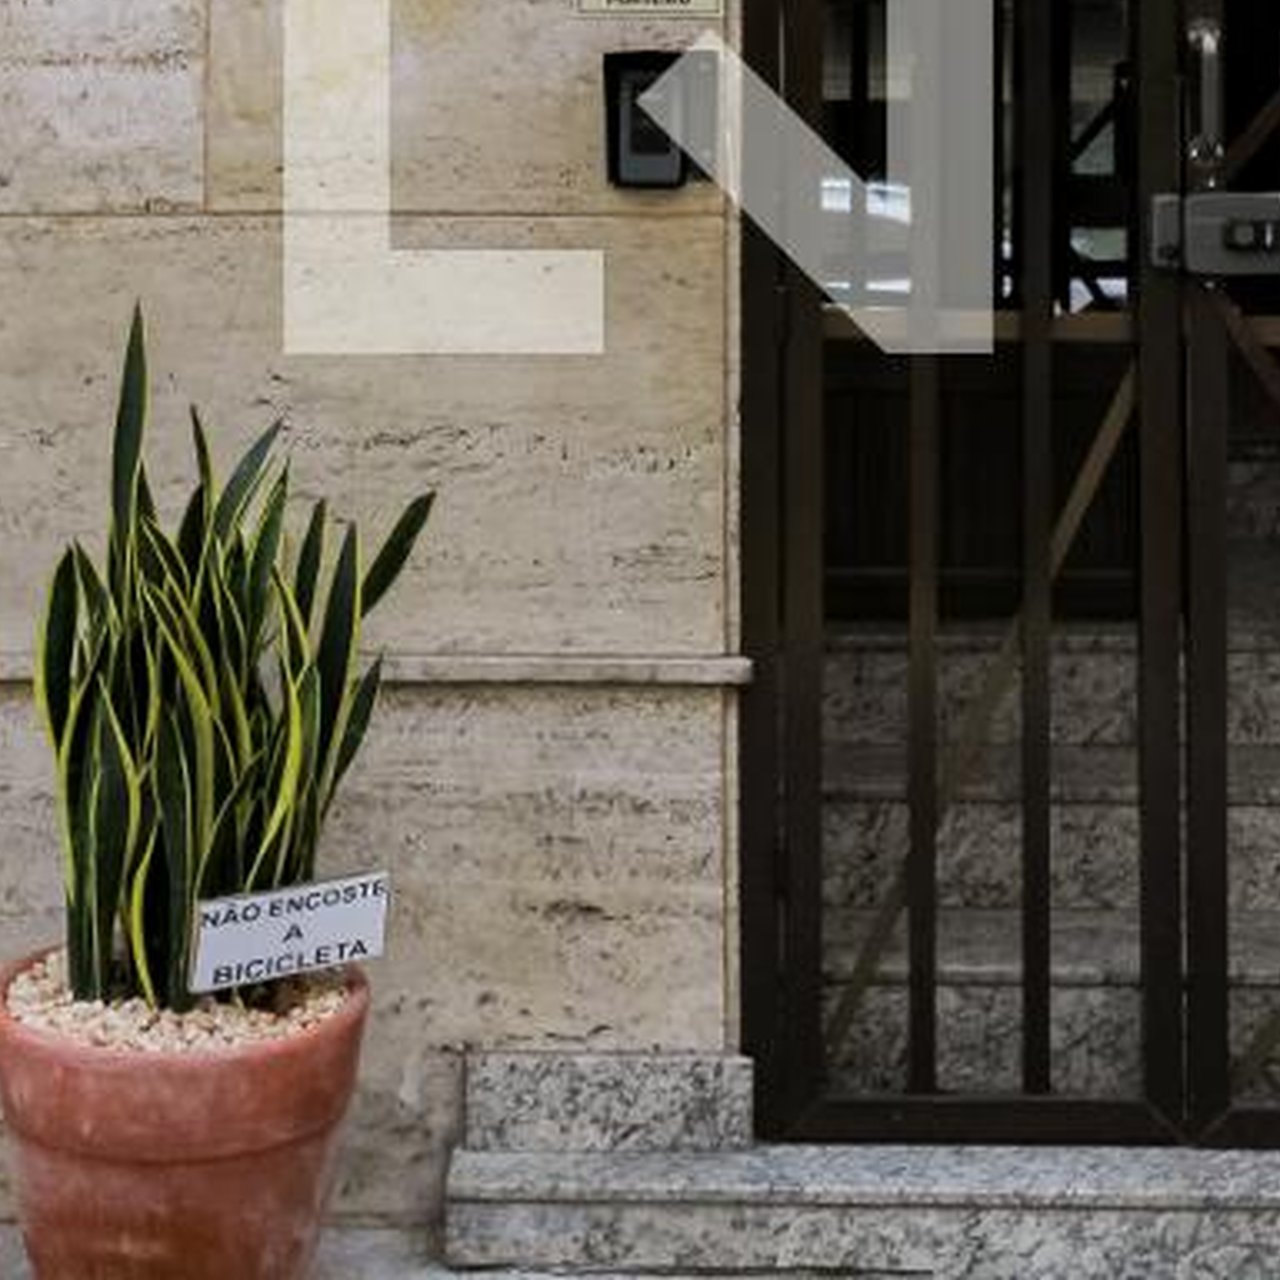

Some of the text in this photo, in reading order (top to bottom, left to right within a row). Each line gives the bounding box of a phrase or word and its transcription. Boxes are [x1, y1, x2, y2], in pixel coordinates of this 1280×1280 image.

[202, 880, 387, 928] NÃO ENCOSTE
[282, 923, 304, 942] A
[212, 939, 368, 985] BICICLETA
